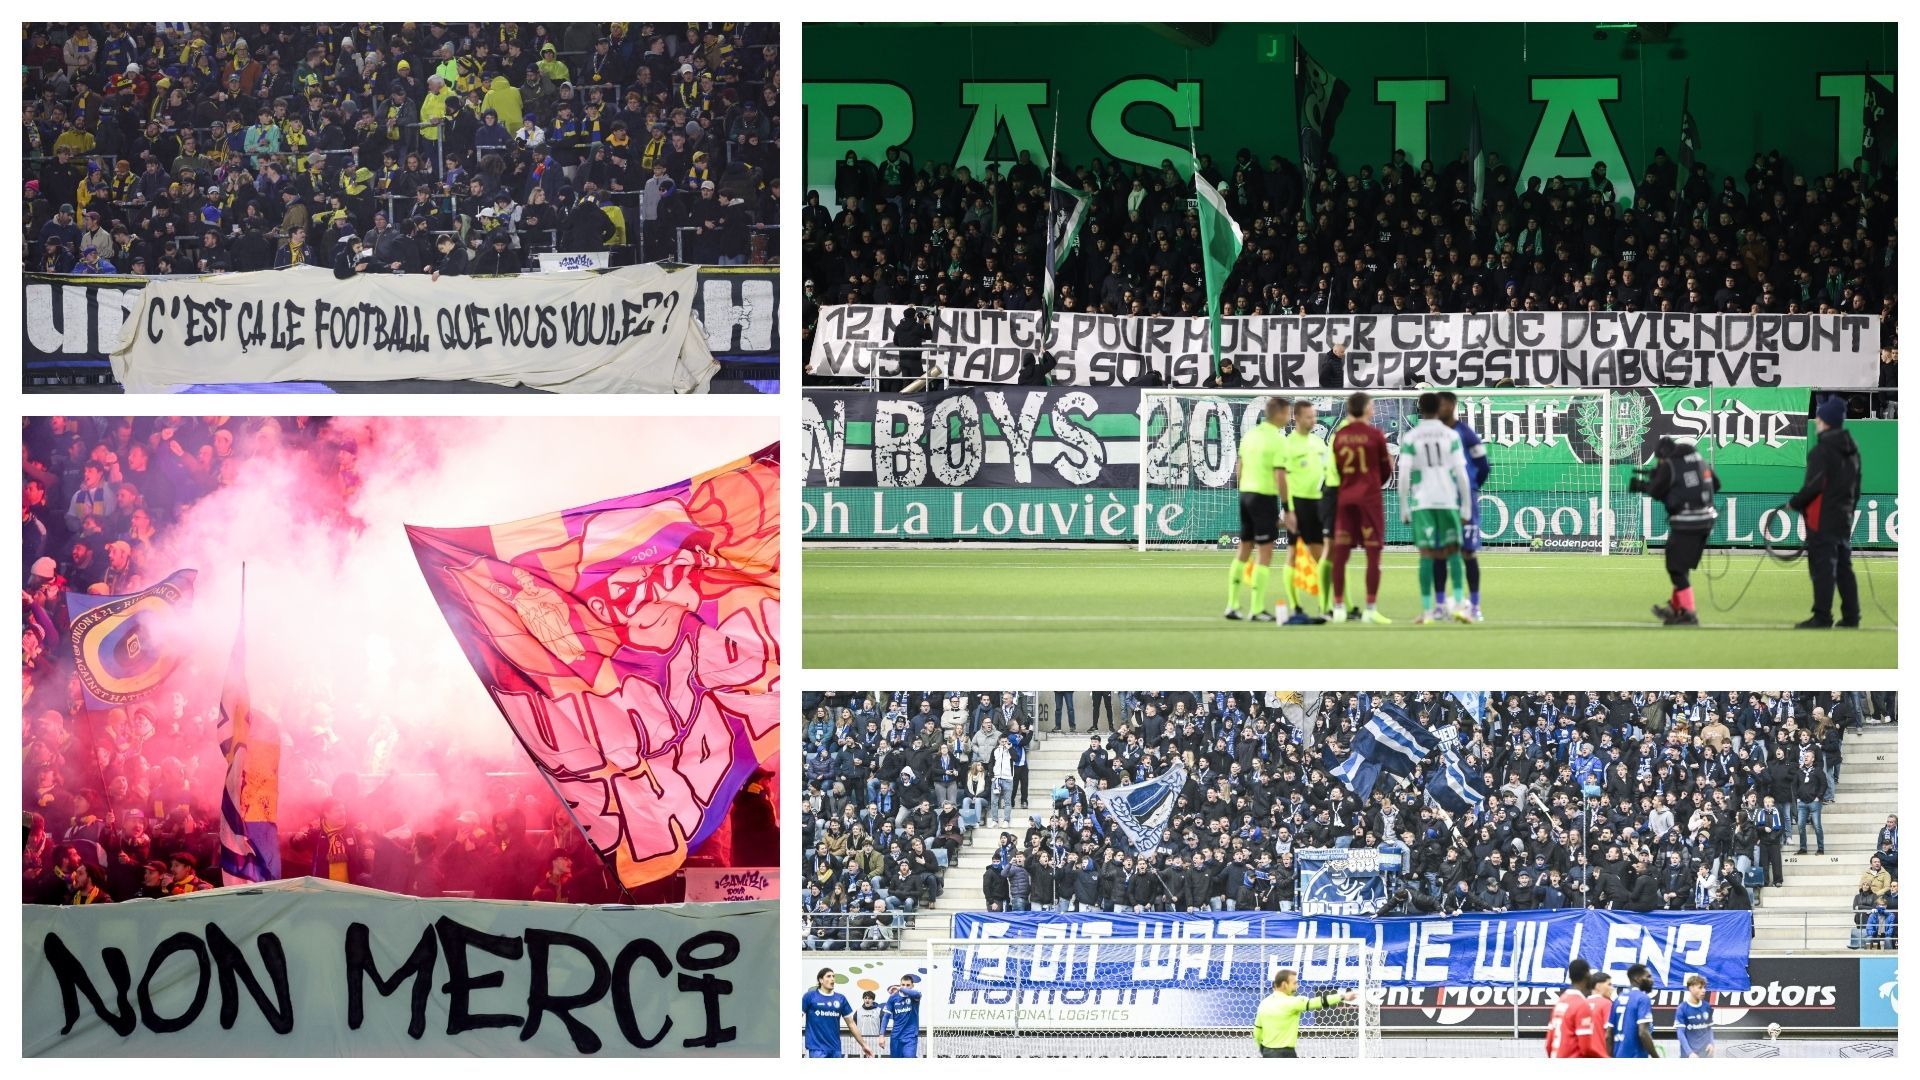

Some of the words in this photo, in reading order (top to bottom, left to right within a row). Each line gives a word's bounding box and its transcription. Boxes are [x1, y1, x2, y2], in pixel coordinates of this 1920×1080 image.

[1266, 39, 1277, 57] J
[271, 299, 305, 351] LE
[315, 298, 429, 353] FOOTBALL
[437, 302, 493, 350] QUE
[496, 301, 557, 350] VOUS
[561, 291, 680, 347] VOULEZ?
[826, 307, 873, 341] 12
[883, 308, 1060, 351] MNUTES
[1071, 314, 1175, 352] POUR
[1183, 315, 1378, 353] MONTRER
[1391, 315, 1450, 350] CE
[1461, 312, 1546, 350] QUE
[1561, 311, 1870, 353] DEVIENDRONT
[919, 344, 1077, 387] TADS
[1209, 353, 1305, 388] EUR
[1318, 350, 1588, 389] EPRESSION
[873, 390, 1103, 488] BOYS
[1672, 396, 1791, 449] Side
[1340, 446, 1368, 474] 21
[1424, 443, 1442, 467] 11
[873, 491, 929, 535] La
[953, 489, 1184, 537] Louvière
[631, 545, 657, 564] 2001
[1038, 703, 1049, 721] 26
[1030, 922, 1113, 983] DIT
[1131, 920, 1250, 982] WAT
[1267, 920, 1454, 982] JULLIE
[1472, 919, 1713, 988] WILLEN?
[43, 921, 295, 1038] NON
[948, 1009, 1055, 1022] INTERNATONAL
[1058, 1009, 1130, 1022] LOGISTICS
[1615, 1005, 1626, 1032] 7
